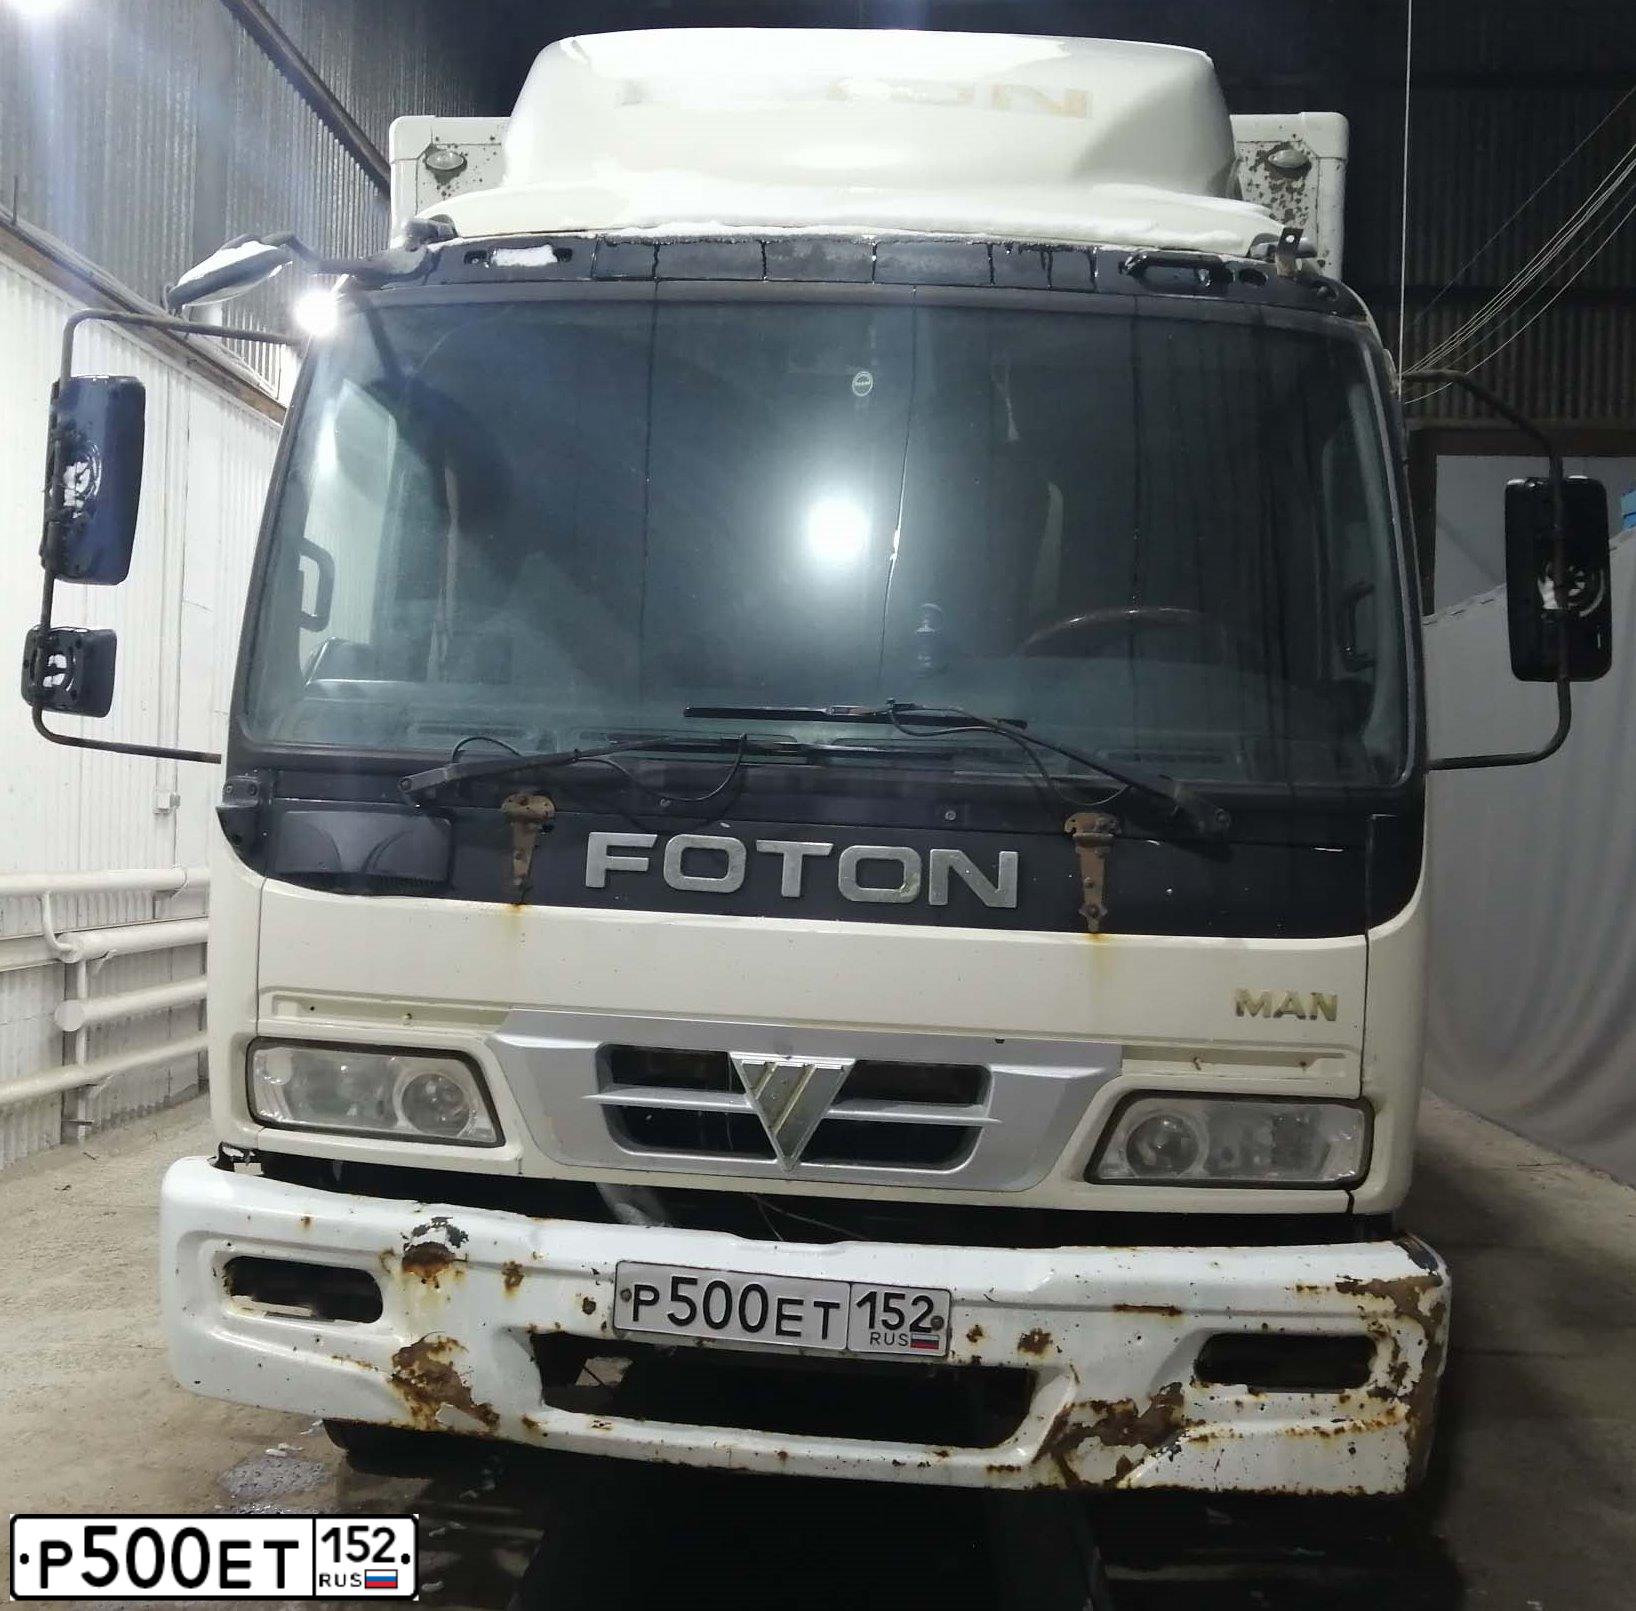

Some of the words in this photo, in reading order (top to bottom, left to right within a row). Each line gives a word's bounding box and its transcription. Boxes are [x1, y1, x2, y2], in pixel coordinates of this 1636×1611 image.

[585, 831, 1018, 908] FOTON
[1234, 988, 1338, 1021] MAN
[856, 1290, 934, 1333] 152
[870, 1331, 908, 1347] RUS
